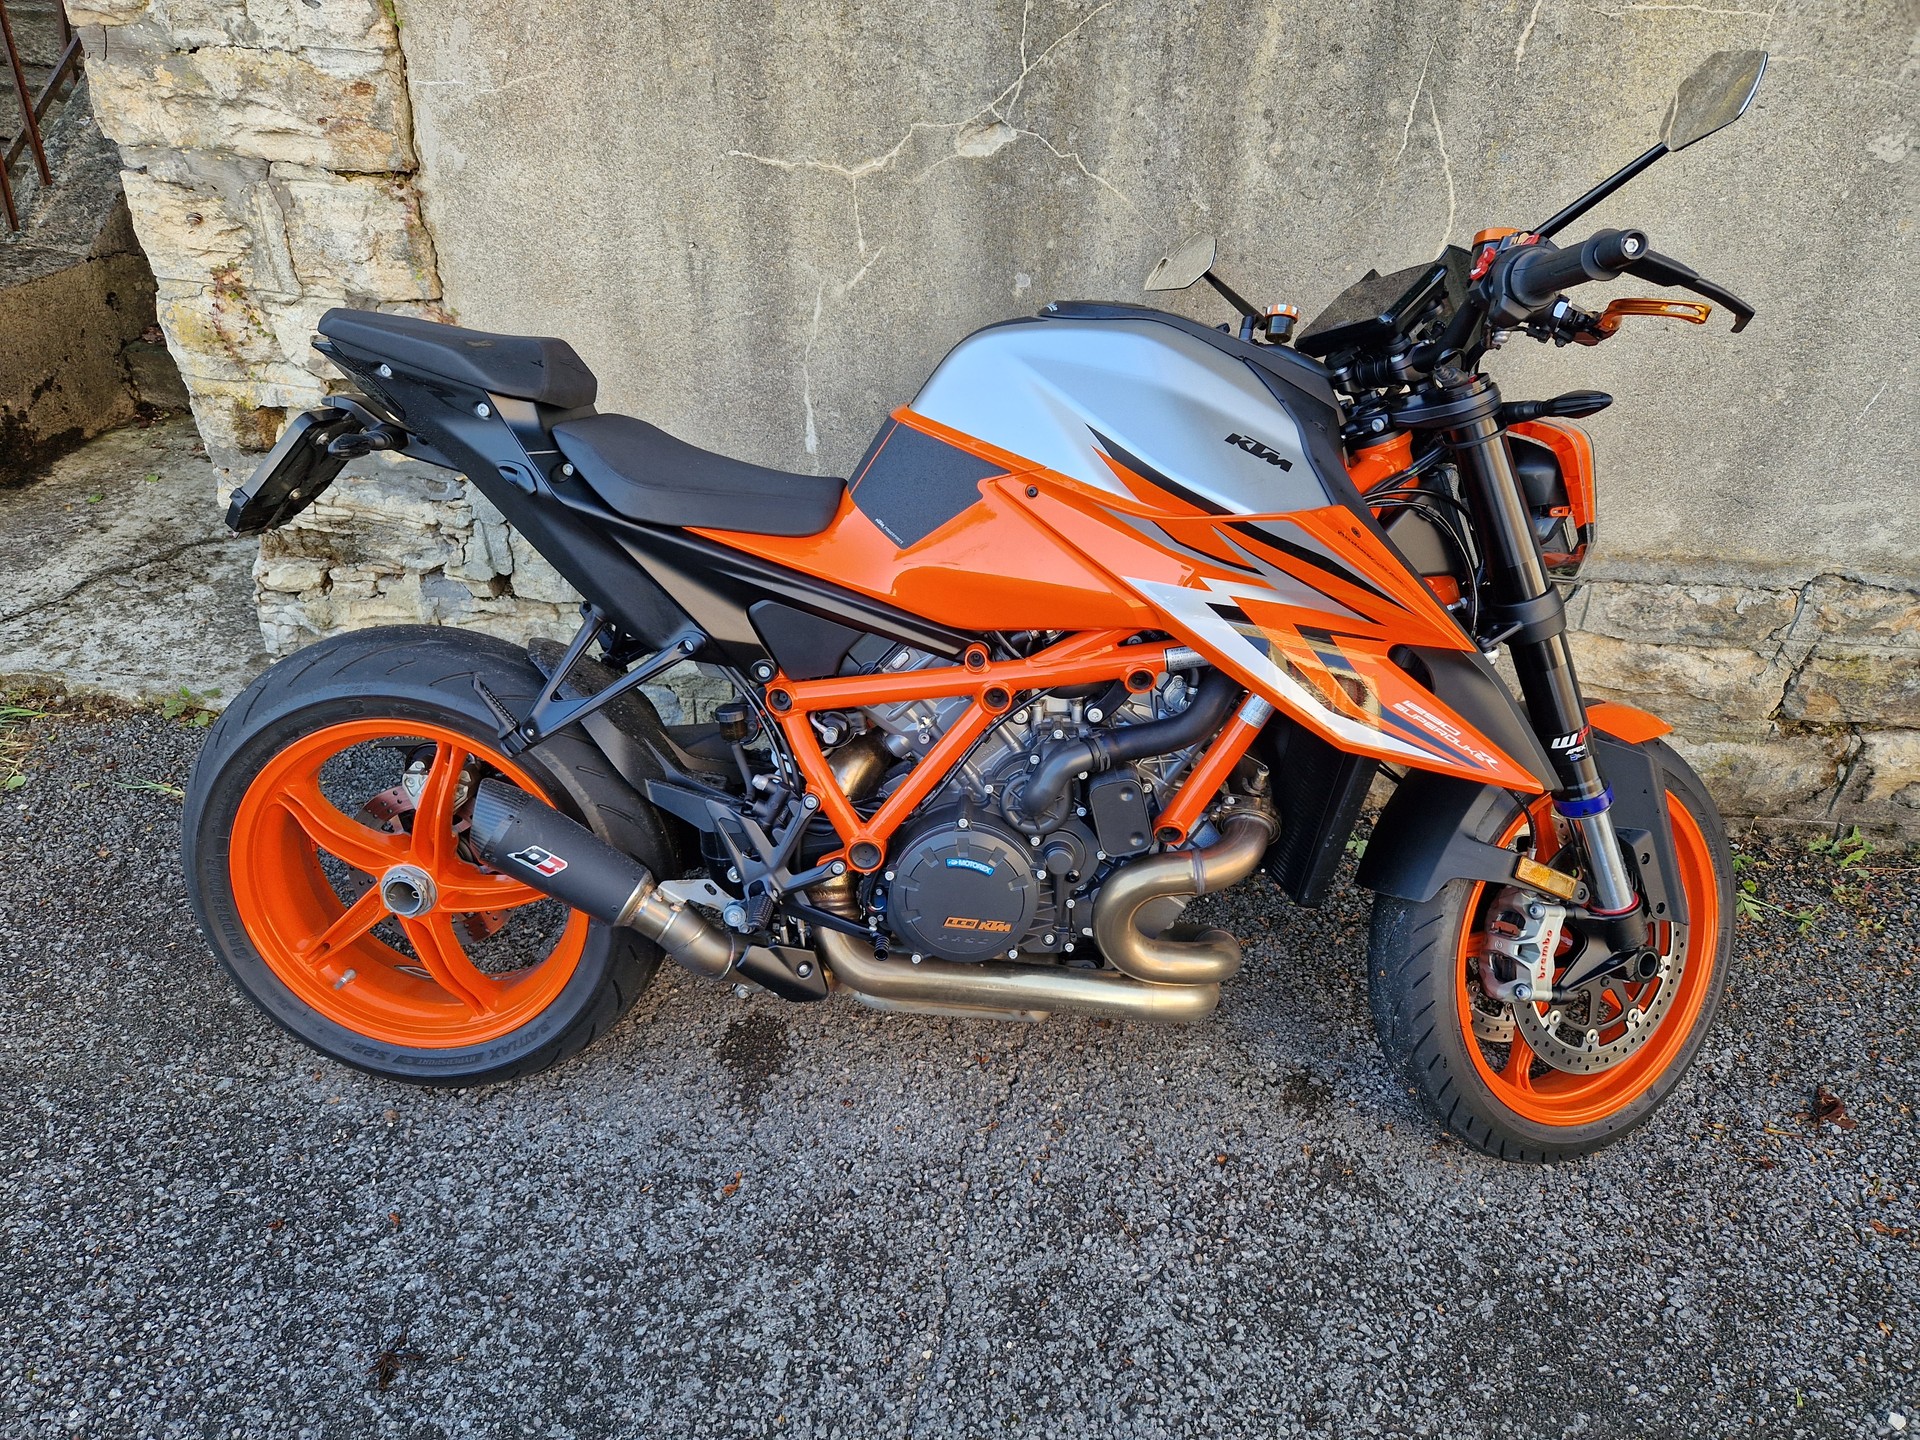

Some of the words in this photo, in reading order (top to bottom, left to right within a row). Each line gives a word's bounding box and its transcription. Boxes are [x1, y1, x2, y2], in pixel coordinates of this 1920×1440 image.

[1224, 432, 1293, 473] KTM
[1551, 726, 1590, 749] WP
[958, 859, 991, 874] MOTOREX
[978, 920, 1012, 932] KTM
[1537, 929, 1553, 981] brembo
